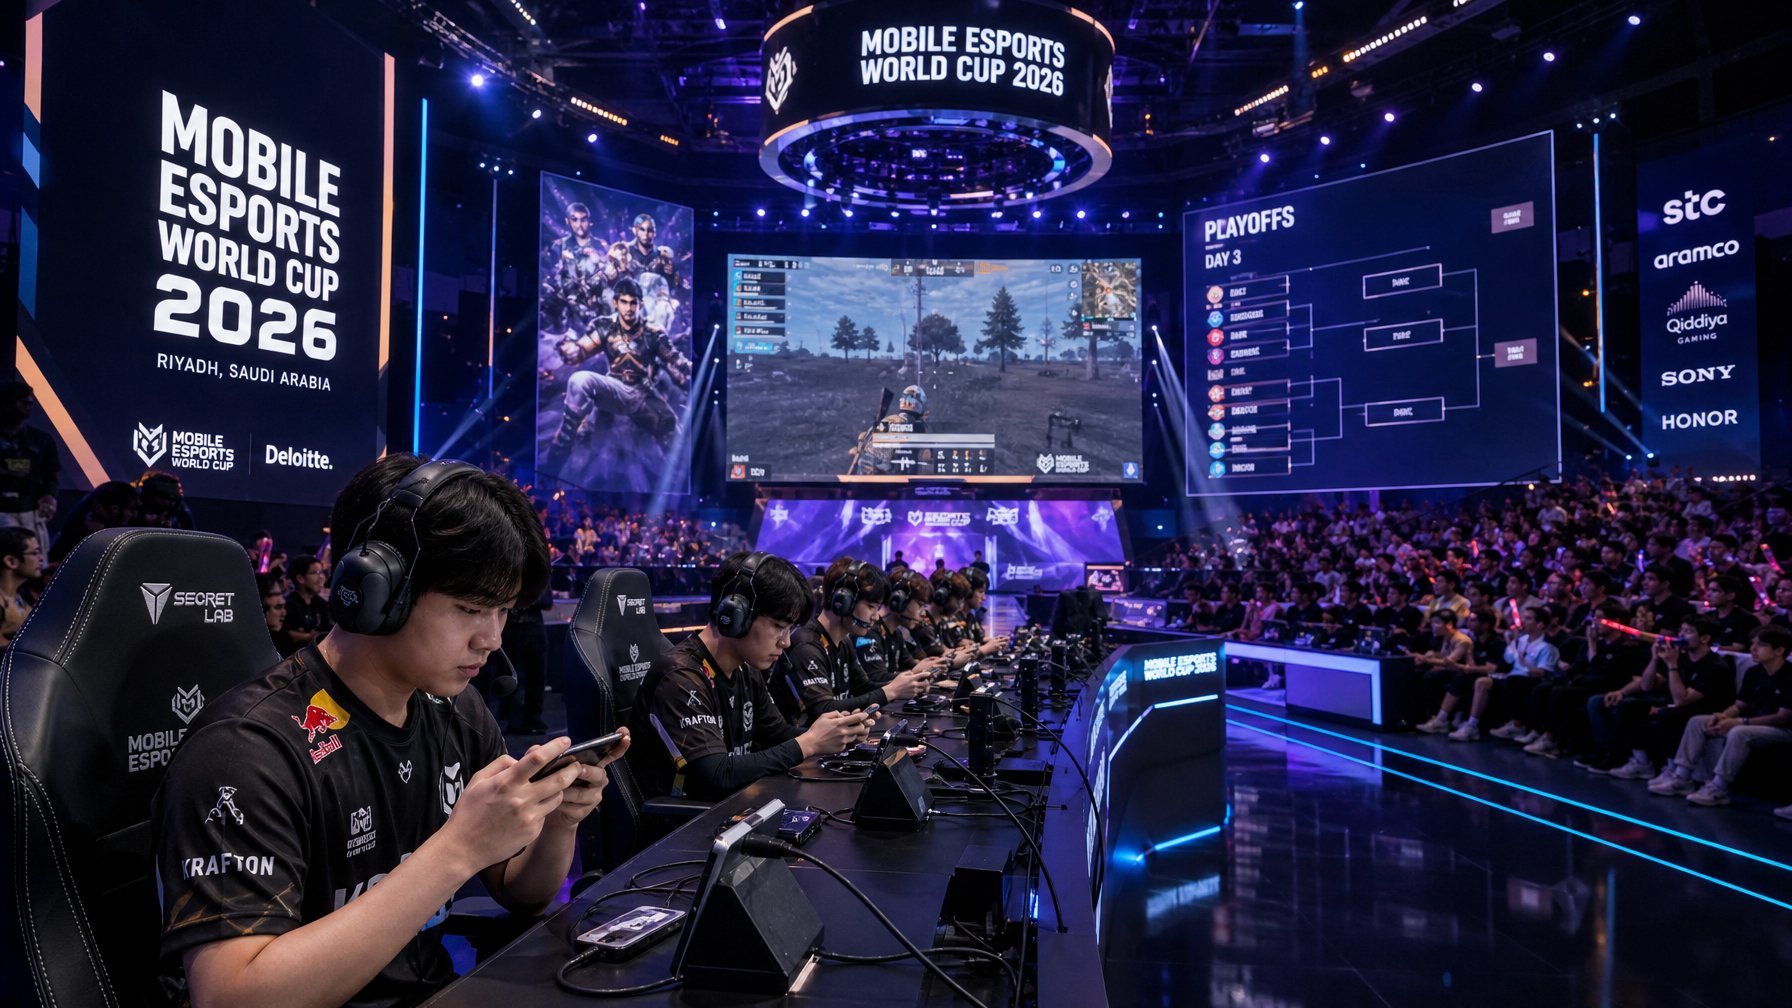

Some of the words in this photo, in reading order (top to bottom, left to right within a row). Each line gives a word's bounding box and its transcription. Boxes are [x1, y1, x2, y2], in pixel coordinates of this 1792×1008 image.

[861, 26, 957, 57] MOBILE
[965, 27, 1065, 69] ESPORTS
[860, 55, 947, 85] WORLD
[956, 56, 1006, 83] CUP
[1012, 61, 1064, 97] 2026
[161, 89, 341, 218] MOBILE
[160, 159, 340, 264] ESPORTS
[1662, 189, 1726, 225] stc
[1205, 205, 1295, 242] PLAYOFFS
[157, 219, 277, 287] WORLD
[286, 258, 339, 301] CUP
[1205, 251, 1230, 269] DAY
[1232, 249, 1242, 265] 3
[1654, 239, 1740, 269] aramco
[153, 273, 337, 361] 2026
[1667, 314, 1728, 334] Qiddiya
[1677, 333, 1718, 345] GAMING
[157, 353, 224, 379] RIYADH,
[229, 364, 274, 383] SAUDI
[280, 371, 331, 392] ARABIA
[1661, 364, 1736, 387] SONY
[1662, 409, 1738, 430] HONOR
[172, 431, 223, 448] MOBILE
[172, 445, 234, 461] ESPORTS
[172, 457, 210, 470] WORLD
[212, 461, 234, 471] CUP
[265, 444, 333, 470] Deloitte.
[174, 592, 235, 608] SECRET
[204, 609, 234, 623] LAB
[128, 748, 176, 773] ESPO
[181, 852, 275, 881] KRAFTON
